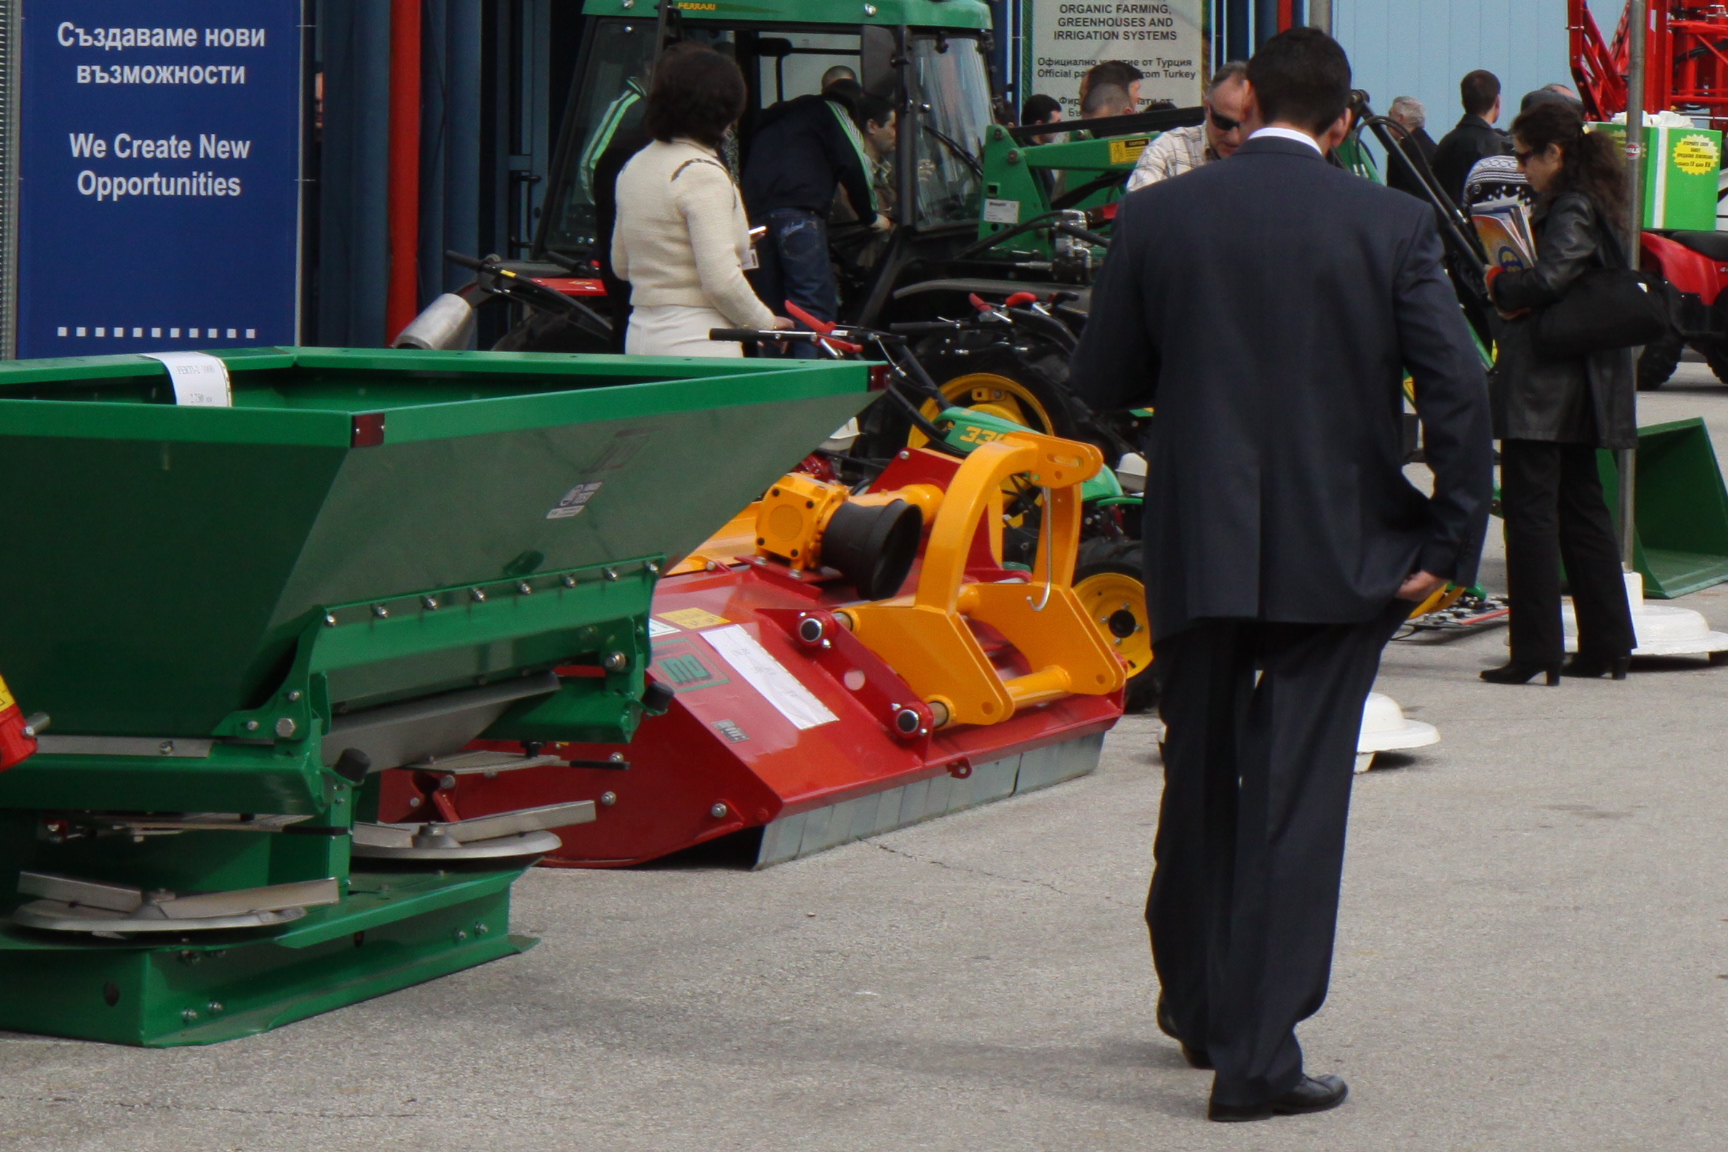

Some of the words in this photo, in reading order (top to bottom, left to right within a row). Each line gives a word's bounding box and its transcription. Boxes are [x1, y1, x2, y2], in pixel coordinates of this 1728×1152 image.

[1059, 4, 1113, 14] ORGANIC
[1115, 4, 1172, 15] FARMING,
[1058, 17, 1146, 27] GREENHOUSES
[1148, 17, 1173, 27] AND
[57, 21, 198, 51] Създаваме
[204, 28, 266, 47] нови
[1054, 30, 1119, 41] IRRIGATION
[1122, 30, 1177, 41] SYSTEMS
[1037, 57, 1097, 67] Официално
[1142, 58, 1154, 66] от
[1156, 57, 1192, 68] Турция
[76, 65, 246, 84] възможности
[1037, 69, 1071, 78] Official
[1142, 70, 1160, 78] rom
[1163, 69, 1196, 80] Turkey
[69, 133, 107, 158] We
[114, 133, 191, 159] Create
[199, 133, 251, 159] New
[77, 169, 241, 202] Opportunities
